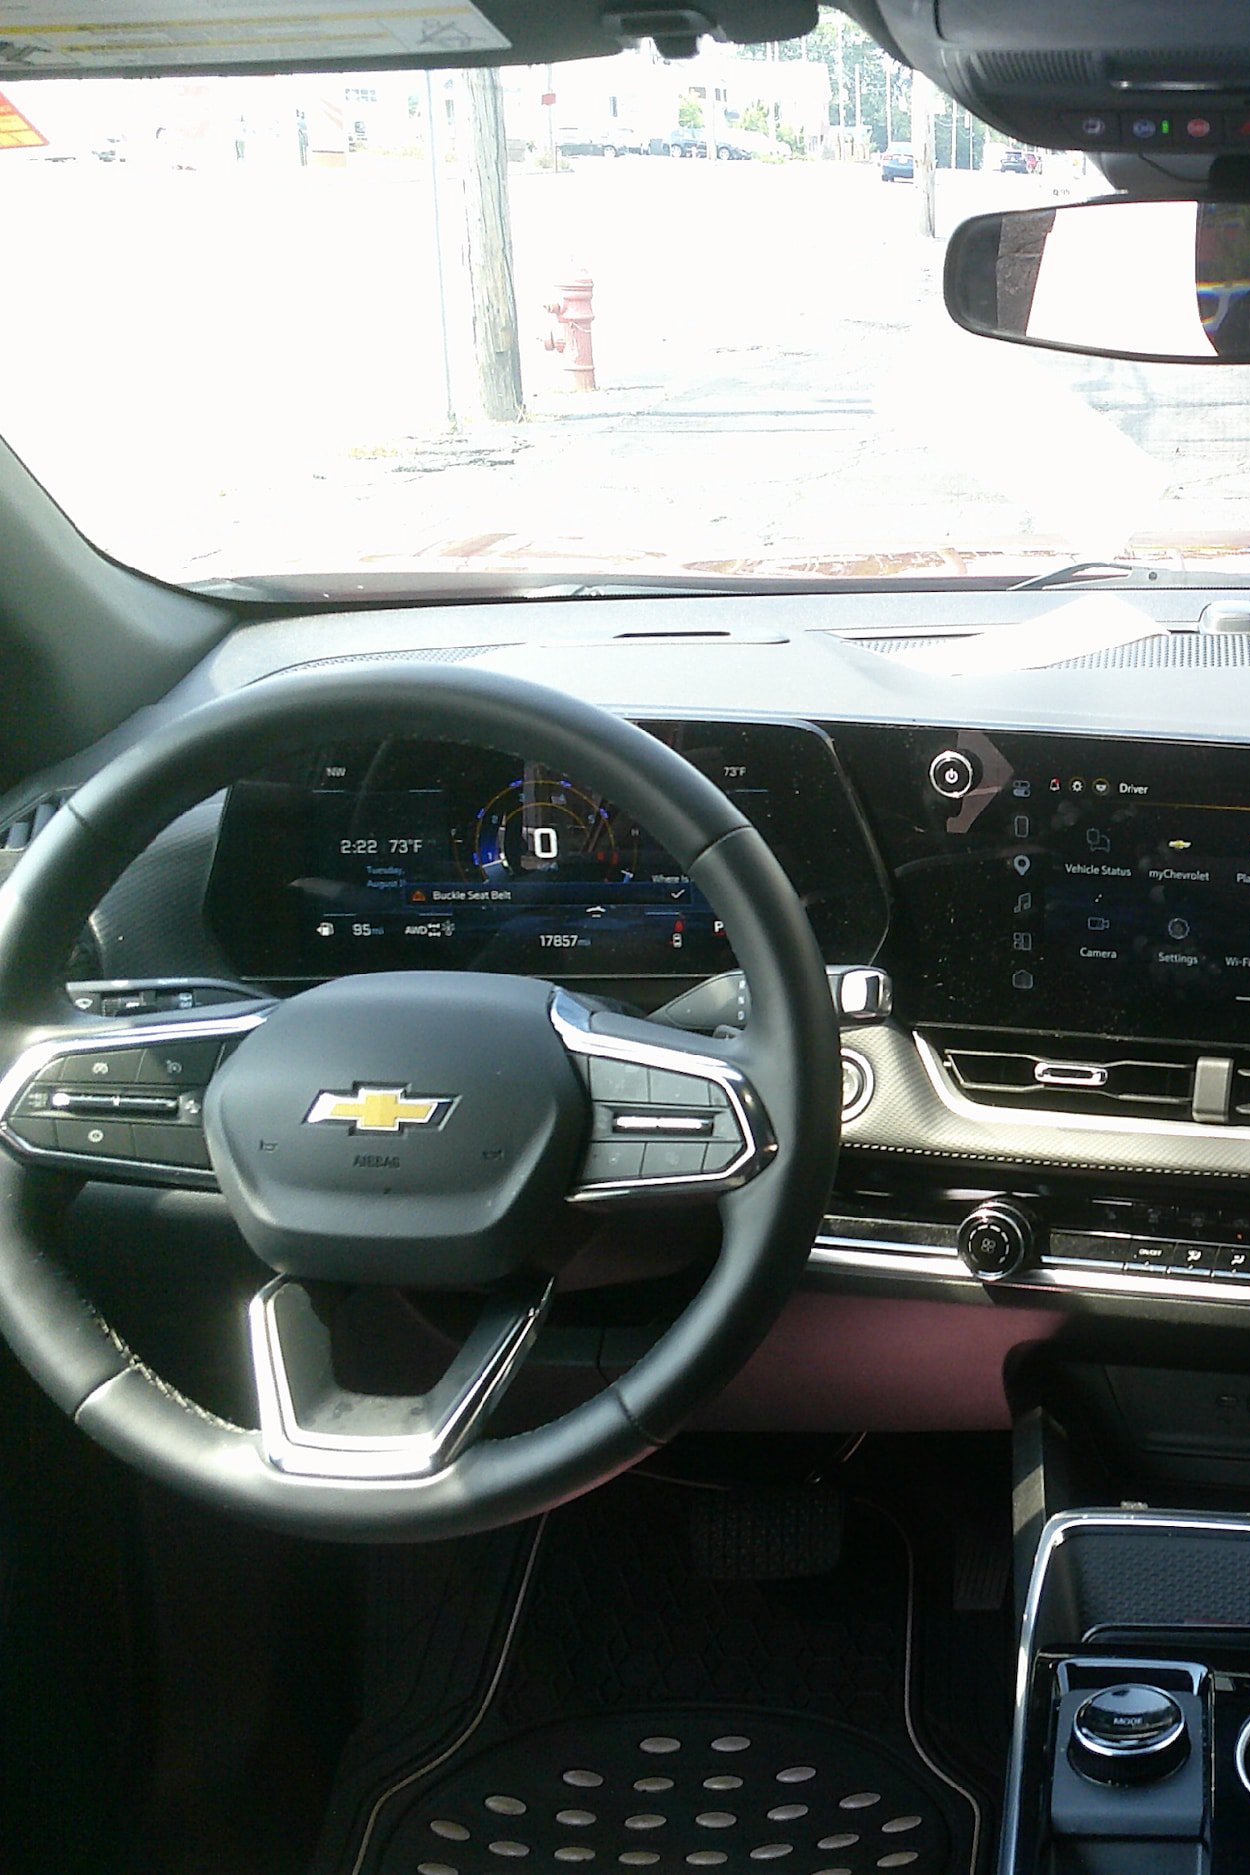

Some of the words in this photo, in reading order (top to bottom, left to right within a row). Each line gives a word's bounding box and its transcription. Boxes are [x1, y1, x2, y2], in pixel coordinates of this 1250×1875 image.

[1119, 782, 1149, 795] Driver
[340, 839, 378, 854] 2:22
[388, 838, 423, 854] 73°F
[533, 827, 558, 859] 0
[1065, 863, 1099, 875] Vehicle
[1101, 865, 1132, 877] Status
[1149, 869, 1211, 882] myChevrolet
[366, 880, 398, 890] August
[432, 890, 466, 900] Buckle
[467, 890, 490, 900] Seat
[490, 890, 512, 900] Belt
[404, 925, 428, 936] AWD
[713, 920, 725, 933] P
[1079, 947, 1117, 959] Camera
[1158, 952, 1198, 966] Settings
[1225, 956, 1250, 968] Wi-Fi
[1113, 1716, 1144, 1727] MODE
